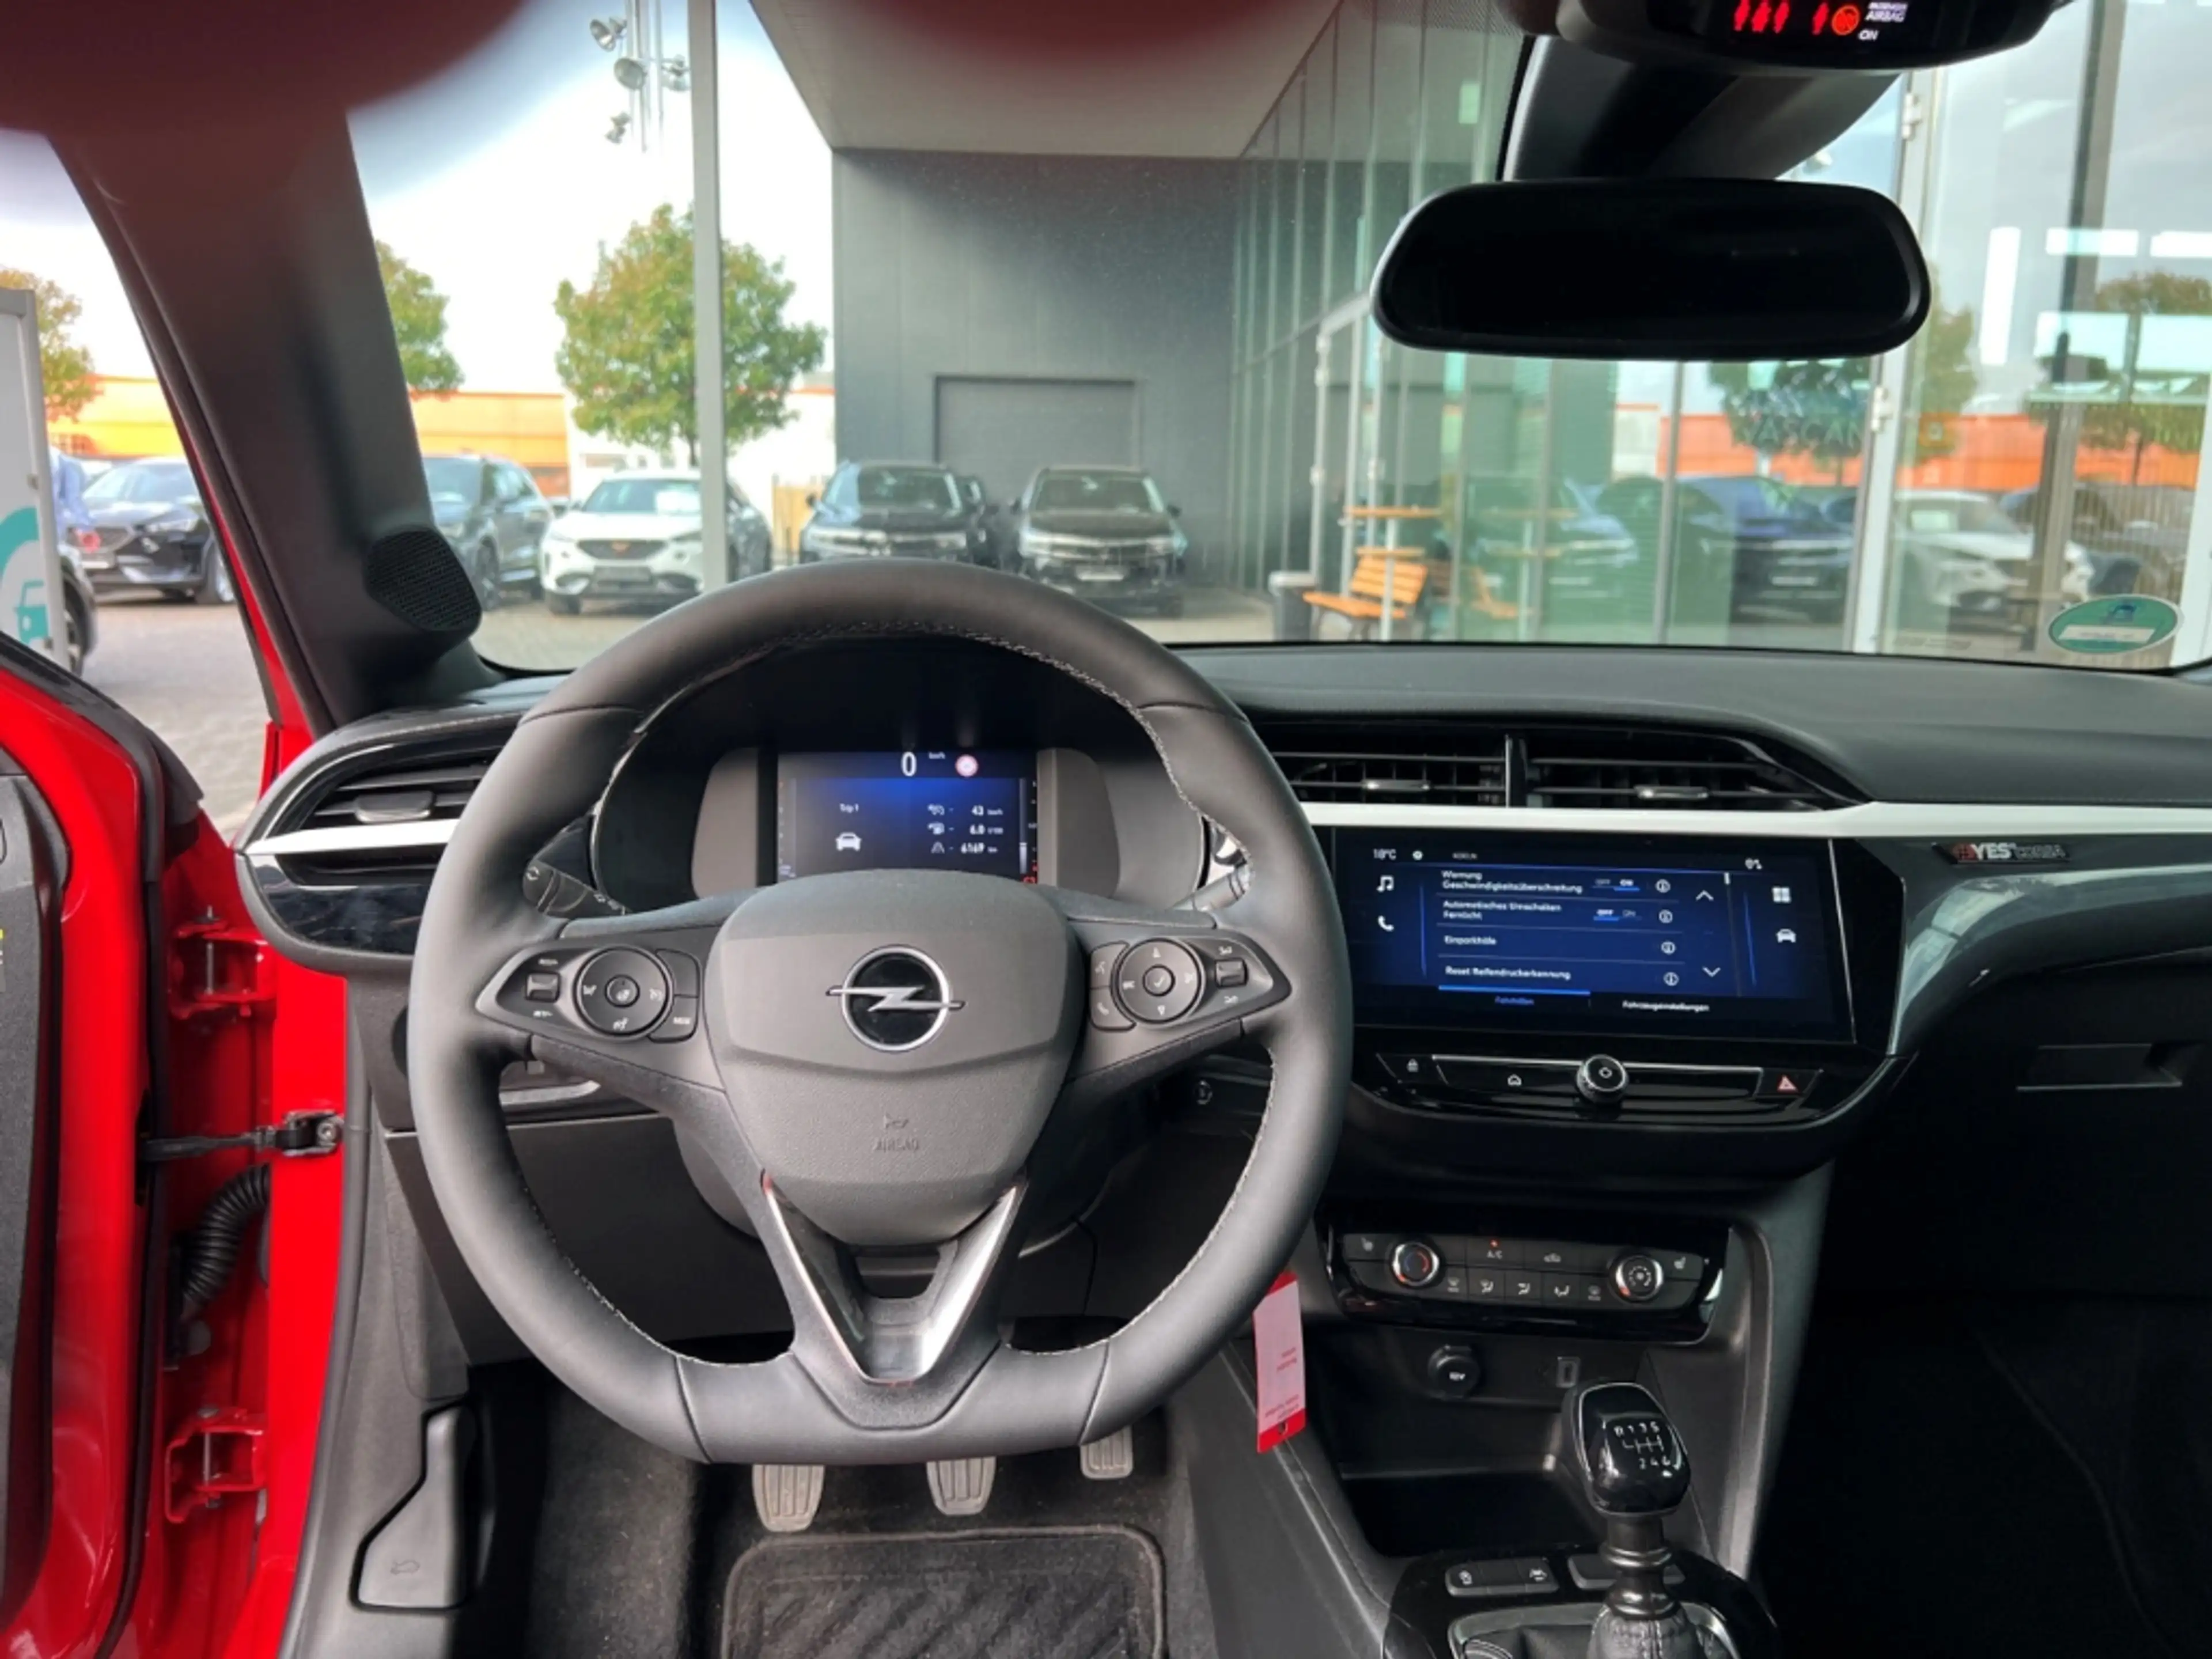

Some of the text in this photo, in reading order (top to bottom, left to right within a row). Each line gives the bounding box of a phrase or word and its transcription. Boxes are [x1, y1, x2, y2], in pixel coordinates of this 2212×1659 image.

[1858, 29, 1878, 40] ON
[902, 751, 916, 777] 0
[1445, 966, 1469, 975] Reset
